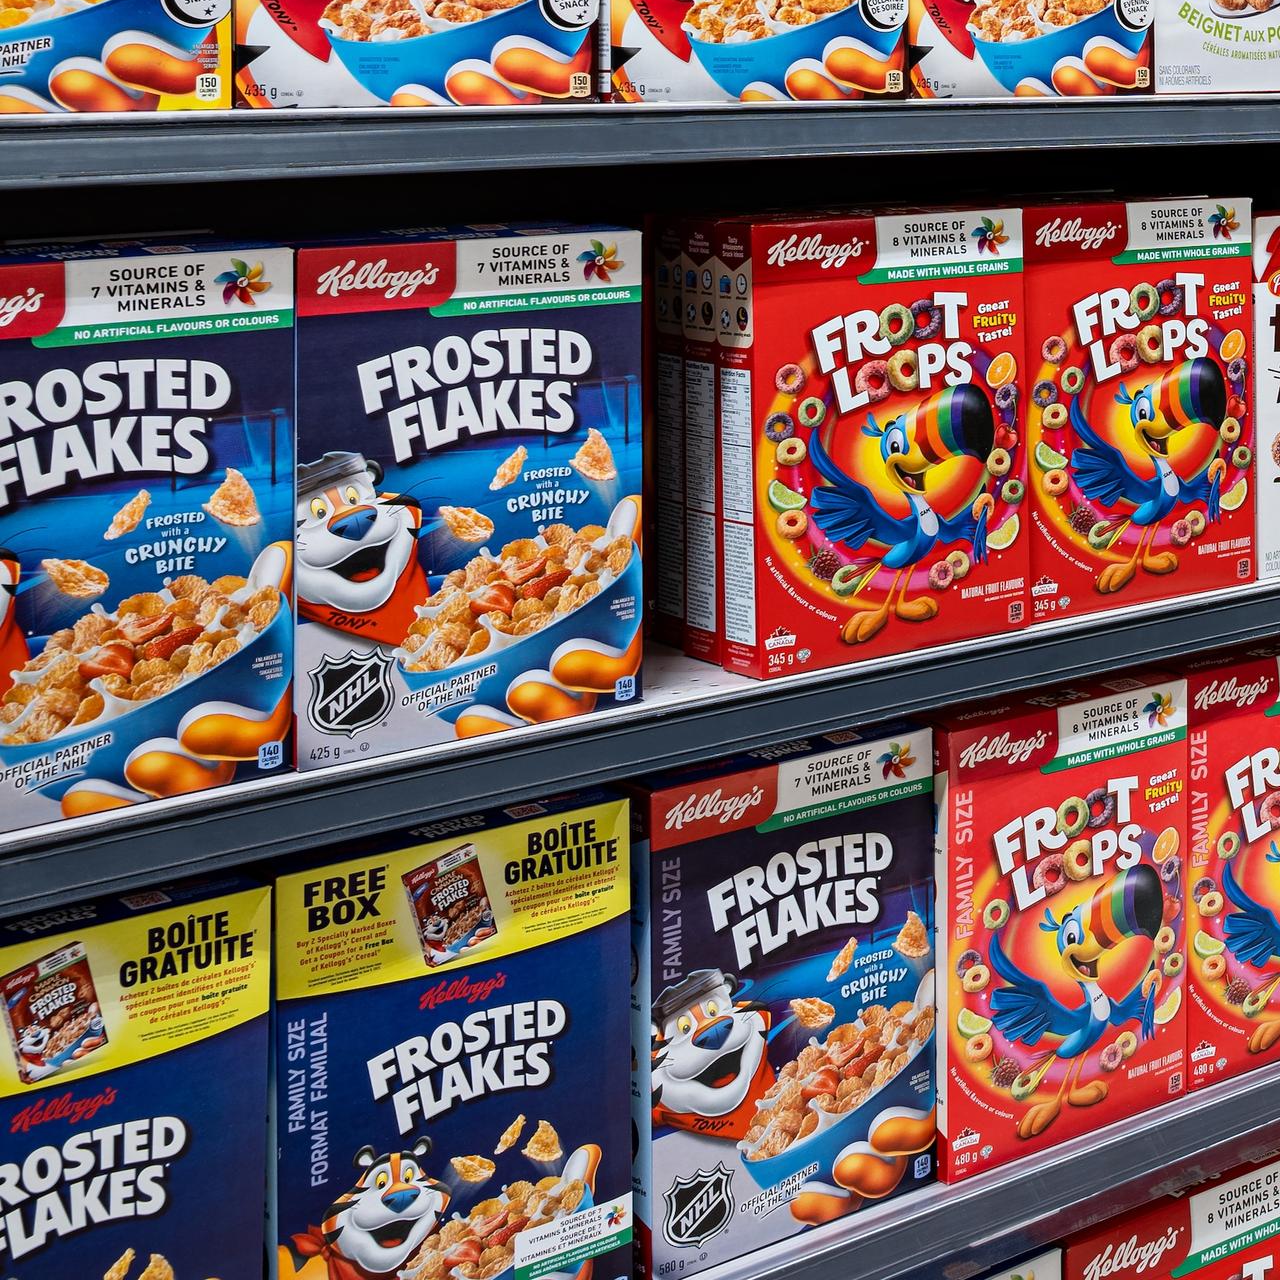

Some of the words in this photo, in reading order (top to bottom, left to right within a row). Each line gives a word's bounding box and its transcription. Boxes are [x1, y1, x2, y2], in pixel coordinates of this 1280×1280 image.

[1178, 2, 1242, 42] BEIGNET
[1243, 30, 1264, 42] AUX
[244, 84, 266, 98] 435
[270, 87, 277, 101] g
[357, 327, 593, 415] FROSTED
[831, 341, 972, 414] LOOPS
[387, 378, 575, 463] FLAKES
[327, 672, 384, 721] NHL
[402, 683, 448, 705] OFFICIAL
[450, 664, 496, 689] PARTNER
[417, 700, 431, 711] OF
[434, 694, 454, 706] THE
[528, 820, 596, 856] BOÎTE
[303, 866, 386, 907] FREE
[308, 891, 382, 932] BOX
[376, 919, 396, 929] Boxes
[287, 1018, 306, 1061] SIZE
[287, 1069, 307, 1132] FAMILY
